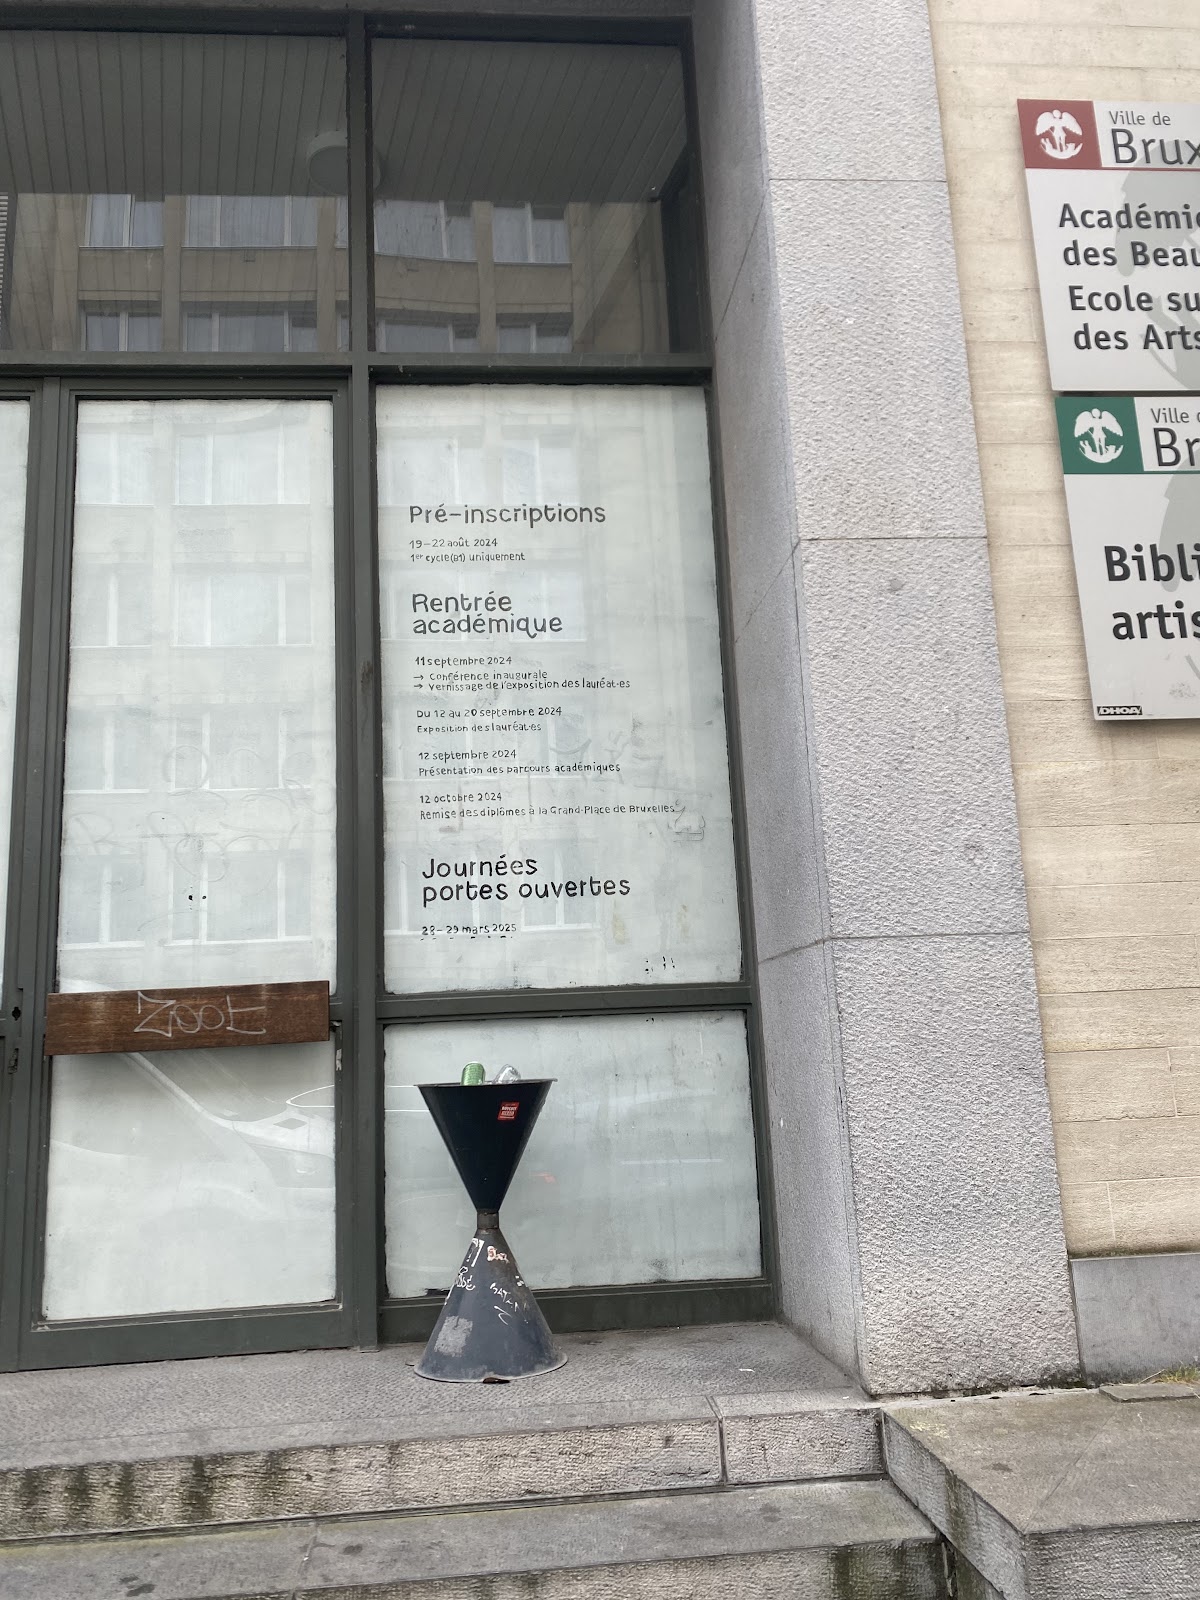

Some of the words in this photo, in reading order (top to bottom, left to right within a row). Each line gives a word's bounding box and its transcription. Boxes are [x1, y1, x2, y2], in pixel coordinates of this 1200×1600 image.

[1109, 110, 1145, 126] Ville
[1152, 111, 1171, 126] de
[1058, 203, 1200, 229] Académi
[1063, 240, 1117, 266] des
[1069, 285, 1153, 311] Ecole
[1073, 323, 1129, 350] des
[1150, 407, 1190, 424] Ville
[1153, 427, 1200, 467] Br
[410, 503, 606, 528] Pré-inscriptions
[447, 537, 470, 547] août
[474, 538, 497, 547] 2024
[469, 552, 525, 562] uniquement
[412, 591, 512, 613] Rentrée
[413, 613, 563, 639] académique
[427, 656, 485, 668] septembre
[487, 656, 512, 665] 2024
[493, 669, 548, 680] inaugurale
[485, 681, 499, 690] de
[561, 679, 580, 688] des
[434, 709, 446, 718] 12
[448, 709, 461, 719] au
[464, 709, 478, 718] 20
[479, 707, 535, 719] septembre
[538, 706, 562, 717] 2024
[417, 724, 468, 734] Exposition
[418, 752, 430, 760] 12
[432, 750, 489, 764] septembre
[492, 749, 517, 759] 2024
[418, 764, 483, 777] Présentation
[486, 764, 504, 774] des
[506, 763, 551, 775] parcours
[554, 761, 621, 775] académiques
[420, 794, 431, 804] 12
[433, 792, 474, 804] octobre
[477, 792, 502, 802] 2024
[420, 809, 457, 820] Remise
[459, 808, 479, 818] des
[480, 806, 526, 818] diplômes
[528, 805, 535, 815] à
[538, 805, 548, 815] la
[550, 805, 611, 815] Grand-Place
[613, 803, 626, 814] de
[422, 854, 538, 879] Journées
[422, 881, 508, 907] portes
[519, 876, 631, 899] ouvertes
[462, 924, 490, 936] mars
[492, 923, 517, 934] 2025
